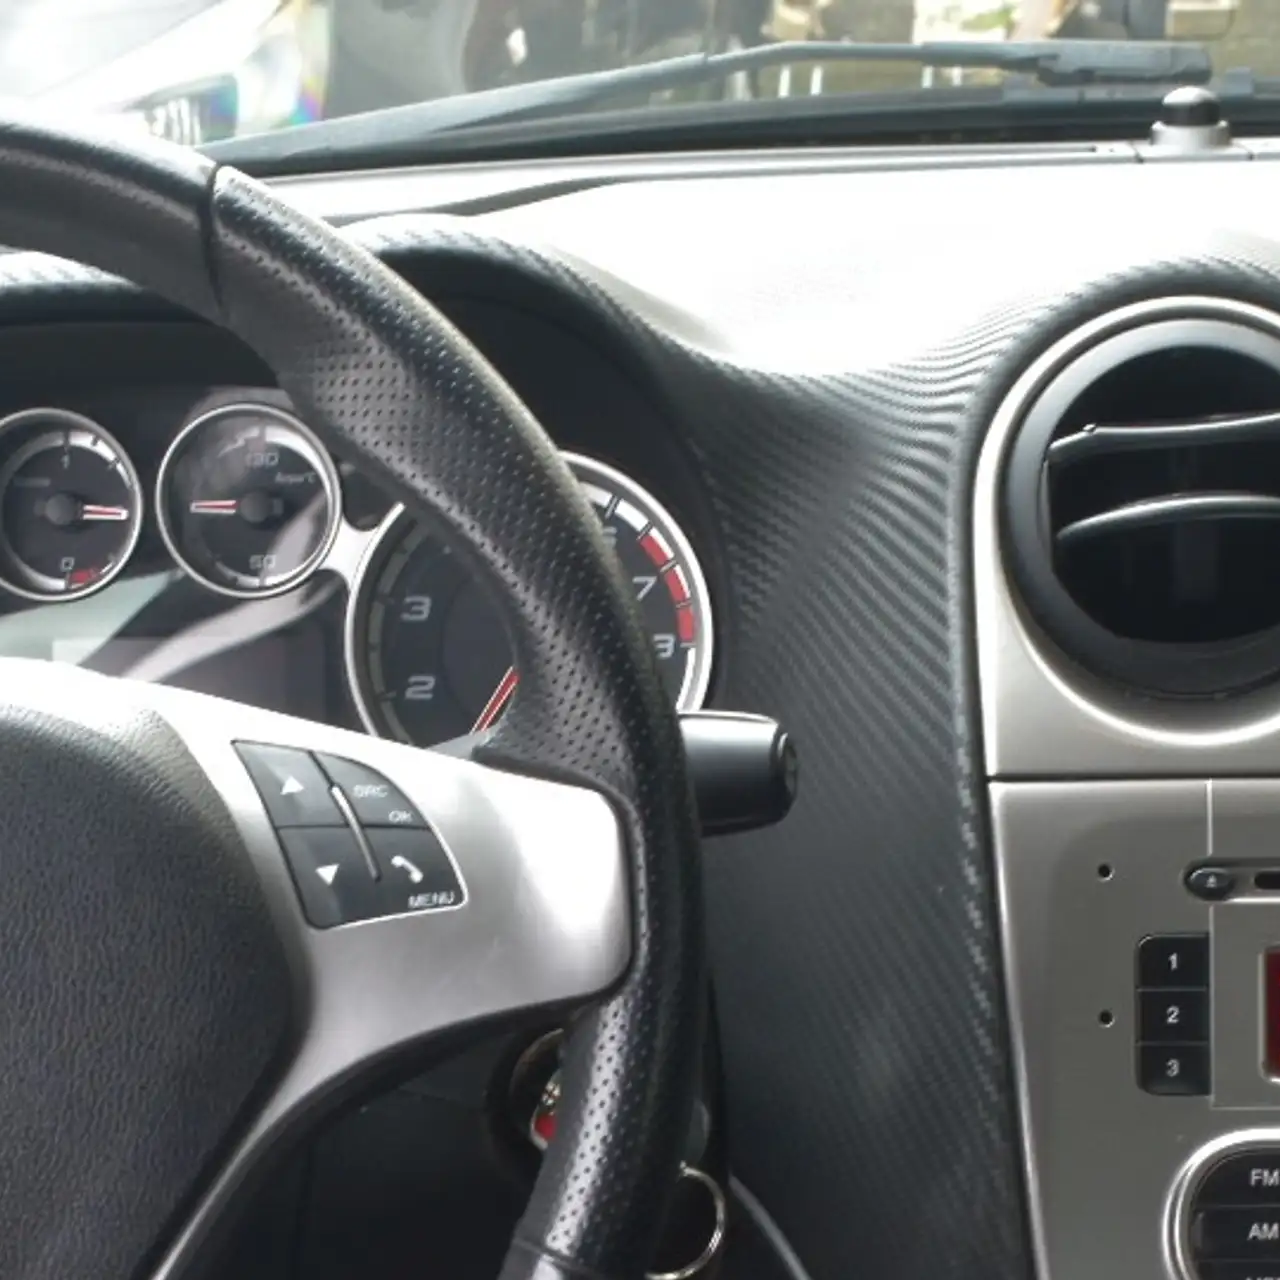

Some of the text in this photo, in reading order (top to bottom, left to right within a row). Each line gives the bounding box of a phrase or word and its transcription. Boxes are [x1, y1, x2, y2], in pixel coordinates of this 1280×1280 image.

[632, 576, 658, 601] 7
[399, 595, 432, 622] 3
[404, 675, 437, 700] 2
[388, 811, 414, 823] OK
[408, 891, 456, 908] MENU
[1167, 952, 1179, 971] 1
[1166, 1006, 1180, 1024] 2
[1166, 1059, 1180, 1077] 3
[1250, 1168, 1280, 1186] FM
[1247, 1223, 1280, 1240] AM
